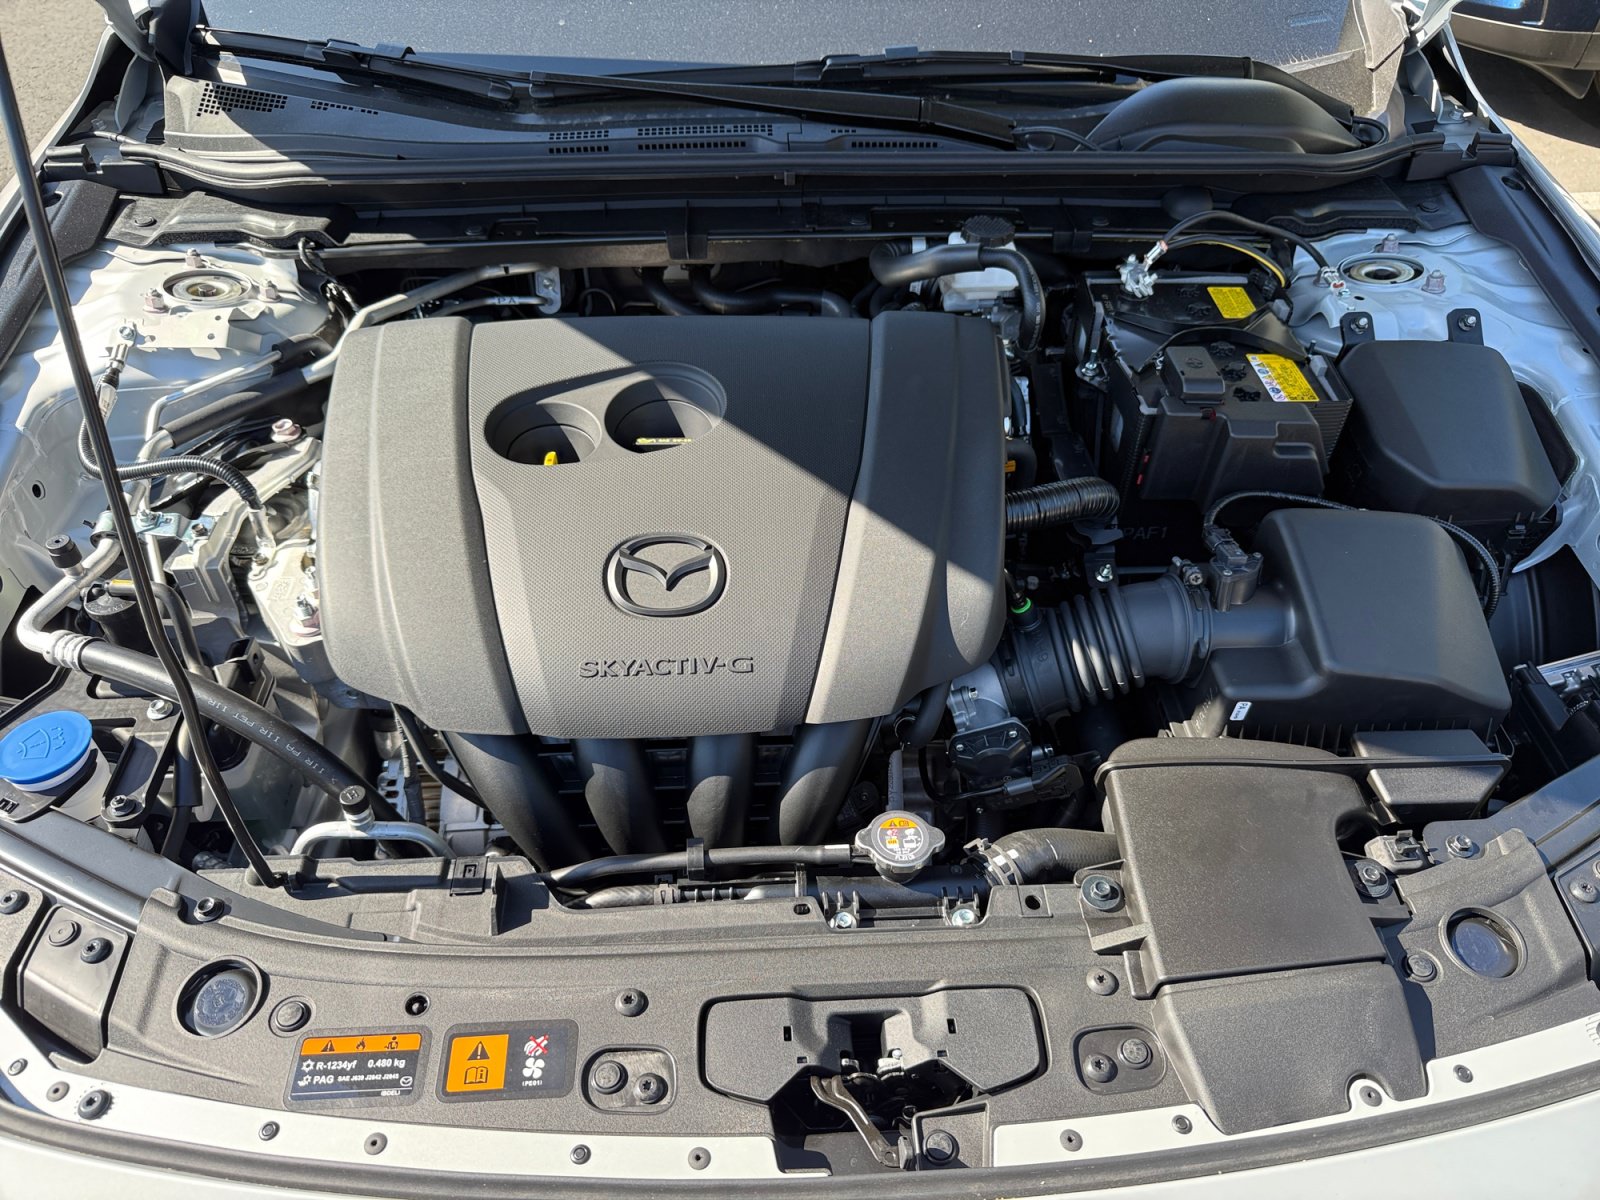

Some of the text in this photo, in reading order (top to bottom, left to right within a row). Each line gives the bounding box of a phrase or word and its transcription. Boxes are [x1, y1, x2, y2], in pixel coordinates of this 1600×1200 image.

[579, 656, 754, 678] SKYACTIV-G
[207, 699, 228, 712] IIR
[232, 712, 255, 728] PET
[259, 726, 280, 742] IIR
[285, 743, 302, 757] PA
[316, 1058, 406, 1071] R-1234yf 0.480 kg
[313, 1075, 335, 1085] PAG
